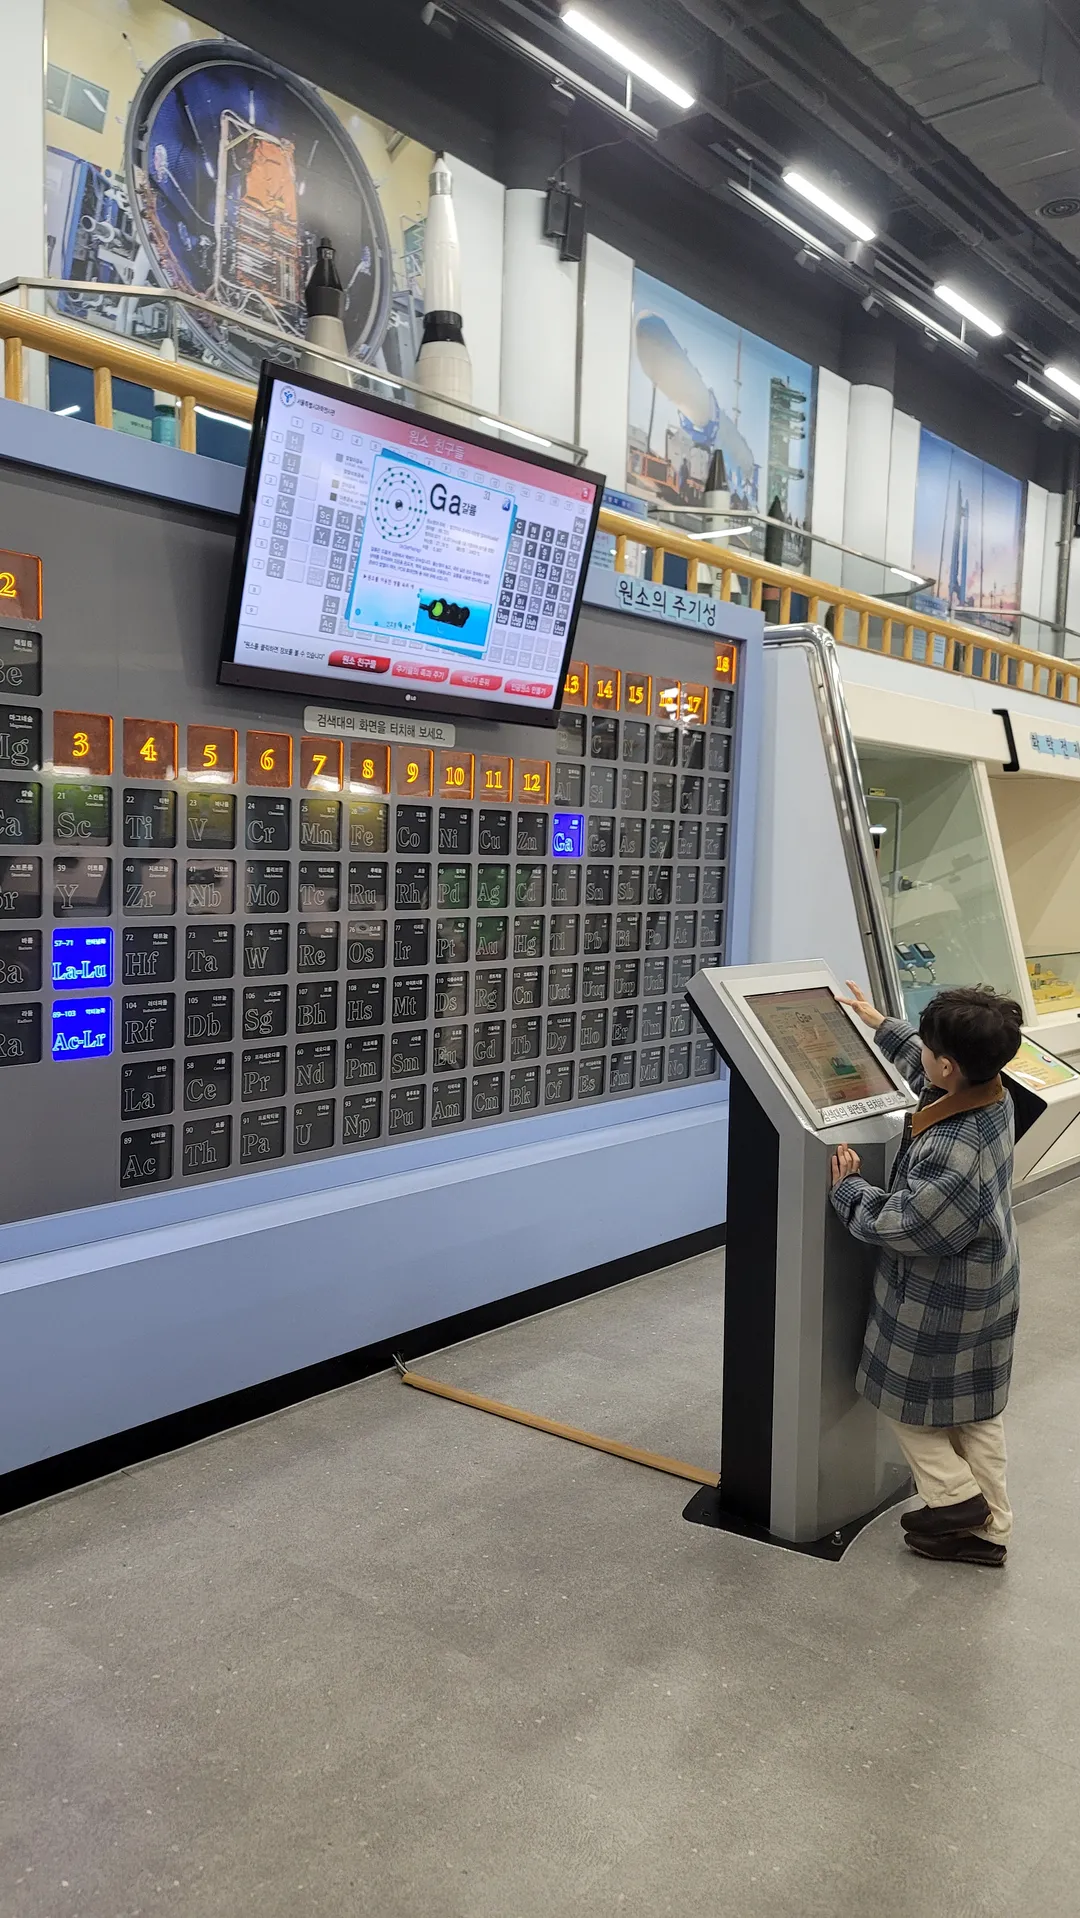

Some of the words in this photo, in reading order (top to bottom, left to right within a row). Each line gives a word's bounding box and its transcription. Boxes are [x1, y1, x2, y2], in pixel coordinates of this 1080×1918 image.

[409, 431, 429, 447] 원소
[435, 438, 464, 461] 친구들
[283, 480, 293, 489] Na
[430, 483, 462, 516] Ga
[484, 491, 491, 500] 31
[320, 512, 330, 520] Sc
[462, 504, 476, 516] 갈륨
[276, 522, 288, 531] Rb
[319, 532, 325, 541] Y
[274, 543, 284, 551] Cs
[0, 573, 17, 597] 2
[326, 600, 336, 608] La
[619, 580, 666, 614] 원소의
[672, 596, 716, 626] 주기성
[323, 621, 333, 629] Ac
[343, 655, 355, 665] 원소
[357, 659, 376, 669] 친구들
[716, 656, 729, 672] 18
[564, 675, 579, 693] 13
[597, 680, 613, 698] 14
[629, 686, 644, 704] 15
[688, 696, 701, 713] 17
[317, 714, 355, 730] 검색대의
[359, 719, 386, 734] 화면을
[390, 723, 415, 738] 터치해
[420, 727, 445, 741] 보세요.
[72, 732, 89, 756] 3
[140, 737, 157, 762] 4
[202, 744, 217, 767] 5
[260, 749, 274, 770] 6
[312, 755, 327, 776] 7
[362, 759, 374, 779] 8
[407, 763, 419, 783] 9
[446, 767, 465, 786] 10
[486, 770, 502, 788] 11
[524, 774, 541, 791] 12
[57, 812, 91, 838] Sc
[125, 815, 153, 839] Ti
[189, 818, 208, 841] V
[248, 820, 275, 843] Cr
[301, 823, 333, 845] Mn
[351, 825, 373, 845] Fe
[397, 827, 420, 848] Co
[439, 828, 458, 849] Ni
[480, 830, 501, 849] Cu
[517, 832, 537, 850] Zn
[554, 832, 573, 852] Ga
[56, 885, 78, 909] Y
[125, 884, 156, 908] Zr
[189, 883, 221, 907] Nb
[246, 884, 279, 906] Mo
[300, 884, 325, 905] Tc
[350, 884, 376, 904] Ru
[396, 883, 420, 903] Rh
[438, 883, 460, 903] Pd
[477, 883, 500, 905] Ag
[516, 883, 536, 901] Cd
[587, 883, 603, 900] Sn
[299, 945, 326, 966] Re
[349, 942, 374, 963] Os
[395, 941, 411, 960] Ir
[437, 939, 455, 958] Pt
[476, 937, 498, 955] Au
[514, 935, 536, 956] Hg
[126, 951, 159, 976] Hf
[187, 950, 218, 972] Ta
[245, 947, 269, 969] W
[53, 961, 107, 980] La-Lu
[436, 993, 456, 1012] Ds
[475, 989, 497, 1010] Rg
[514, 986, 533, 1005] Cn
[298, 1003, 326, 1026] Bh
[348, 1000, 373, 1020] Hs
[394, 996, 416, 1017] Mt
[125, 1018, 156, 1044] Rf
[187, 1012, 220, 1038] Db
[245, 1009, 272, 1034] Sg
[52, 1030, 106, 1051] Ac-Lr
[474, 1039, 496, 1060] Gd
[512, 1035, 531, 1055] Tb
[547, 1032, 567, 1050] Dy
[392, 1053, 419, 1074] Sm
[434, 1047, 457, 1066] Eu
[296, 1062, 325, 1086] Nd
[346, 1058, 377, 1079] Pm
[186, 1079, 217, 1102] Ce
[244, 1072, 270, 1094] Pr
[124, 1088, 155, 1112] La
[474, 1093, 499, 1112] Cm
[510, 1086, 530, 1106] Bk
[390, 1108, 414, 1128] Pu
[432, 1101, 460, 1120] Am
[847, 1103, 868, 1115] 화면을
[296, 1124, 312, 1146] U
[344, 1114, 370, 1137] Np
[185, 1140, 217, 1166] Th
[242, 1134, 270, 1156] Pa
[123, 1155, 156, 1179] Ac
